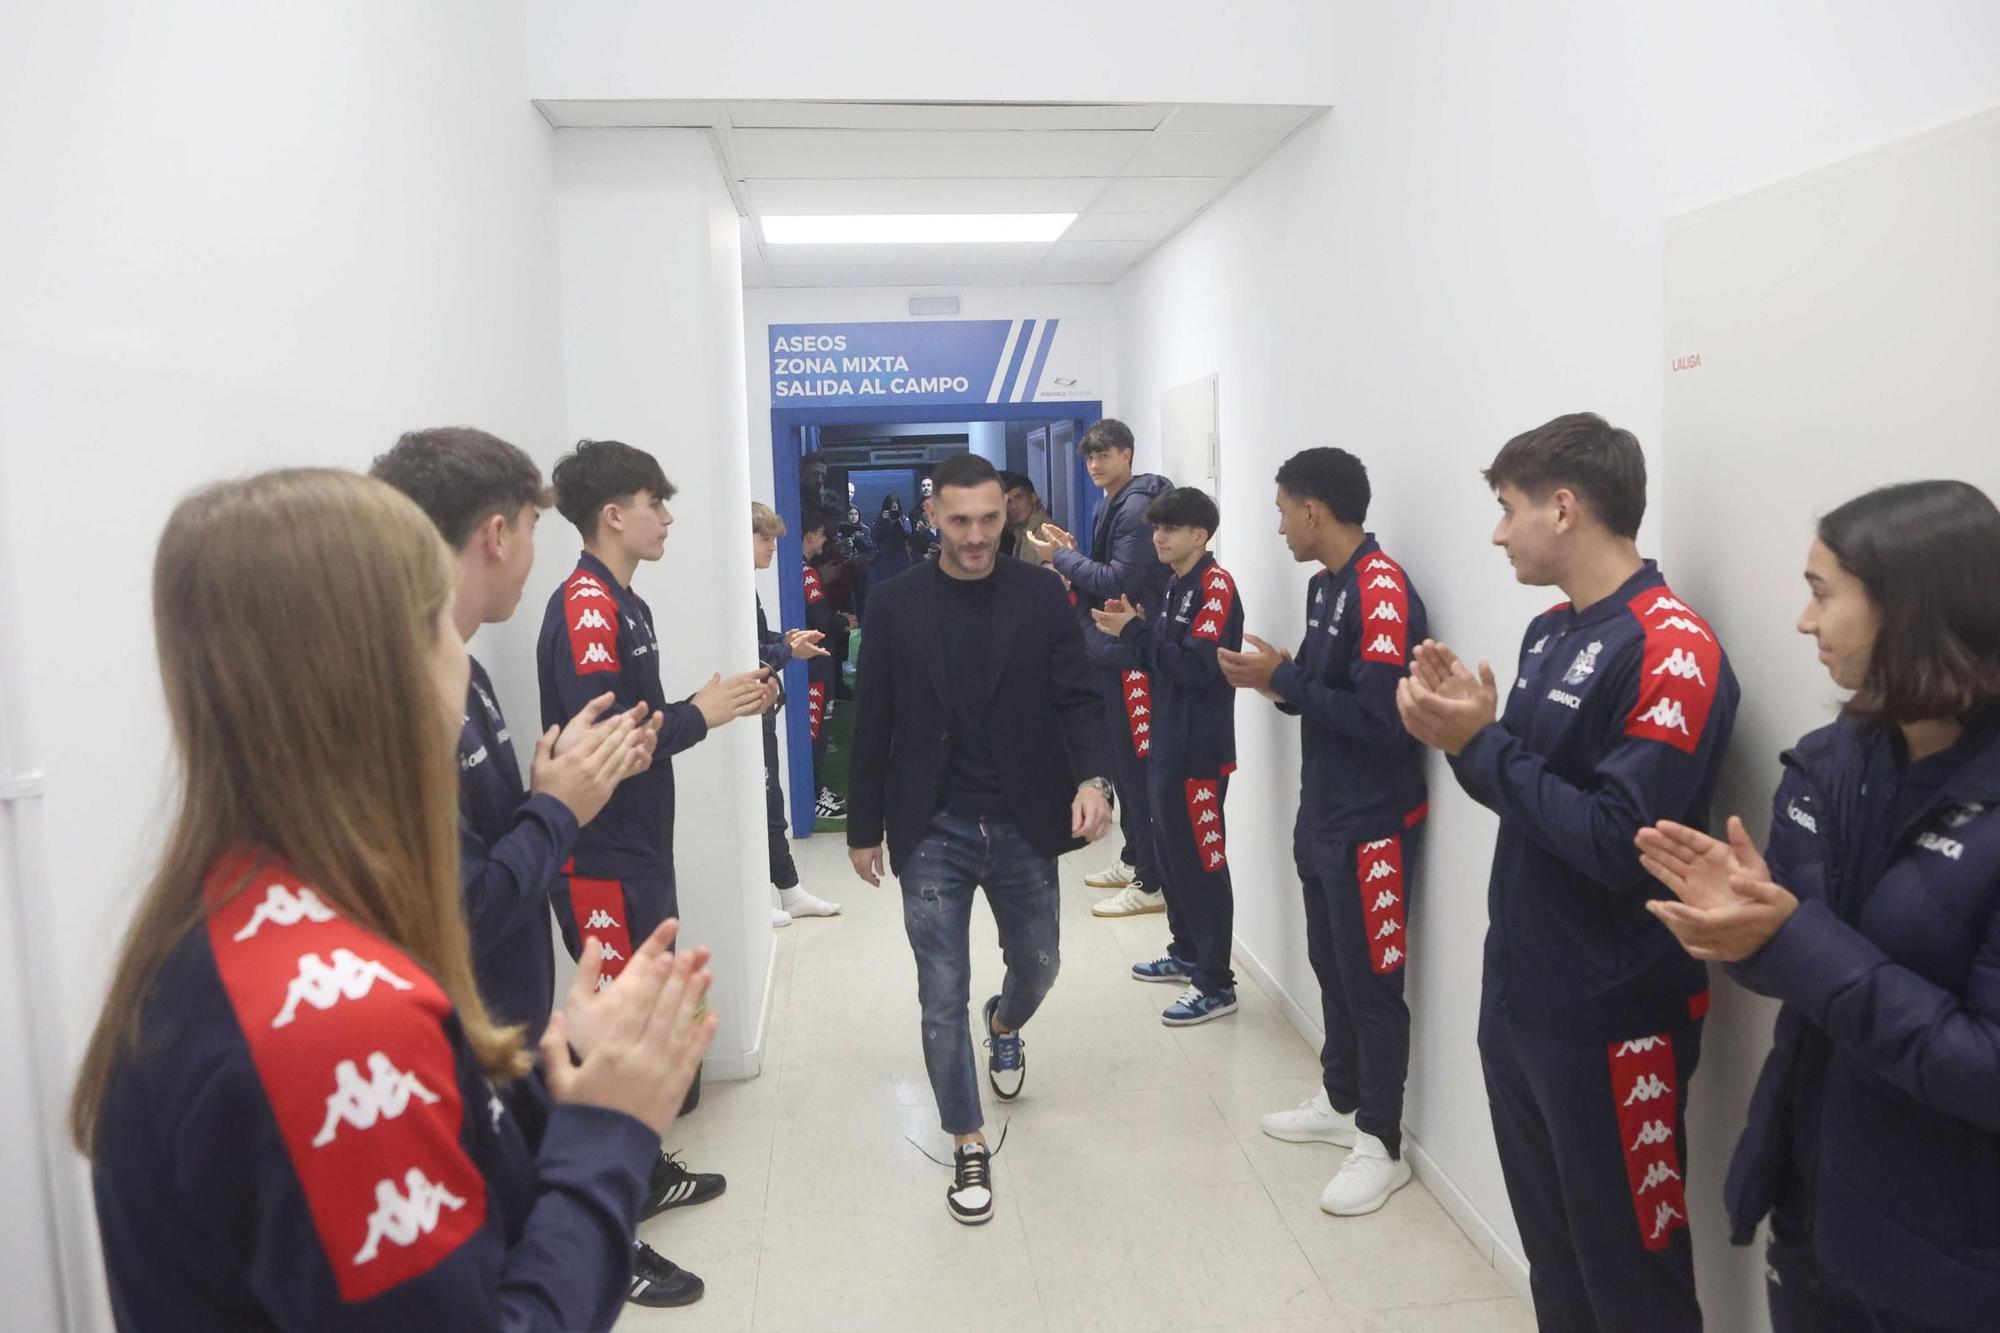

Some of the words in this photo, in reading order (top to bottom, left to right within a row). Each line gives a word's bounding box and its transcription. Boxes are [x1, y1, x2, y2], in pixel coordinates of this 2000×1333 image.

[774, 335, 847, 352] ASEOS
[775, 358, 838, 374] ZONA
[842, 355, 909, 373] MIXTA
[1672, 353, 1701, 371] LALIGA
[776, 379, 854, 396] SALIDA
[858, 378, 886, 394] AL
[890, 377, 969, 393] CAMPO
